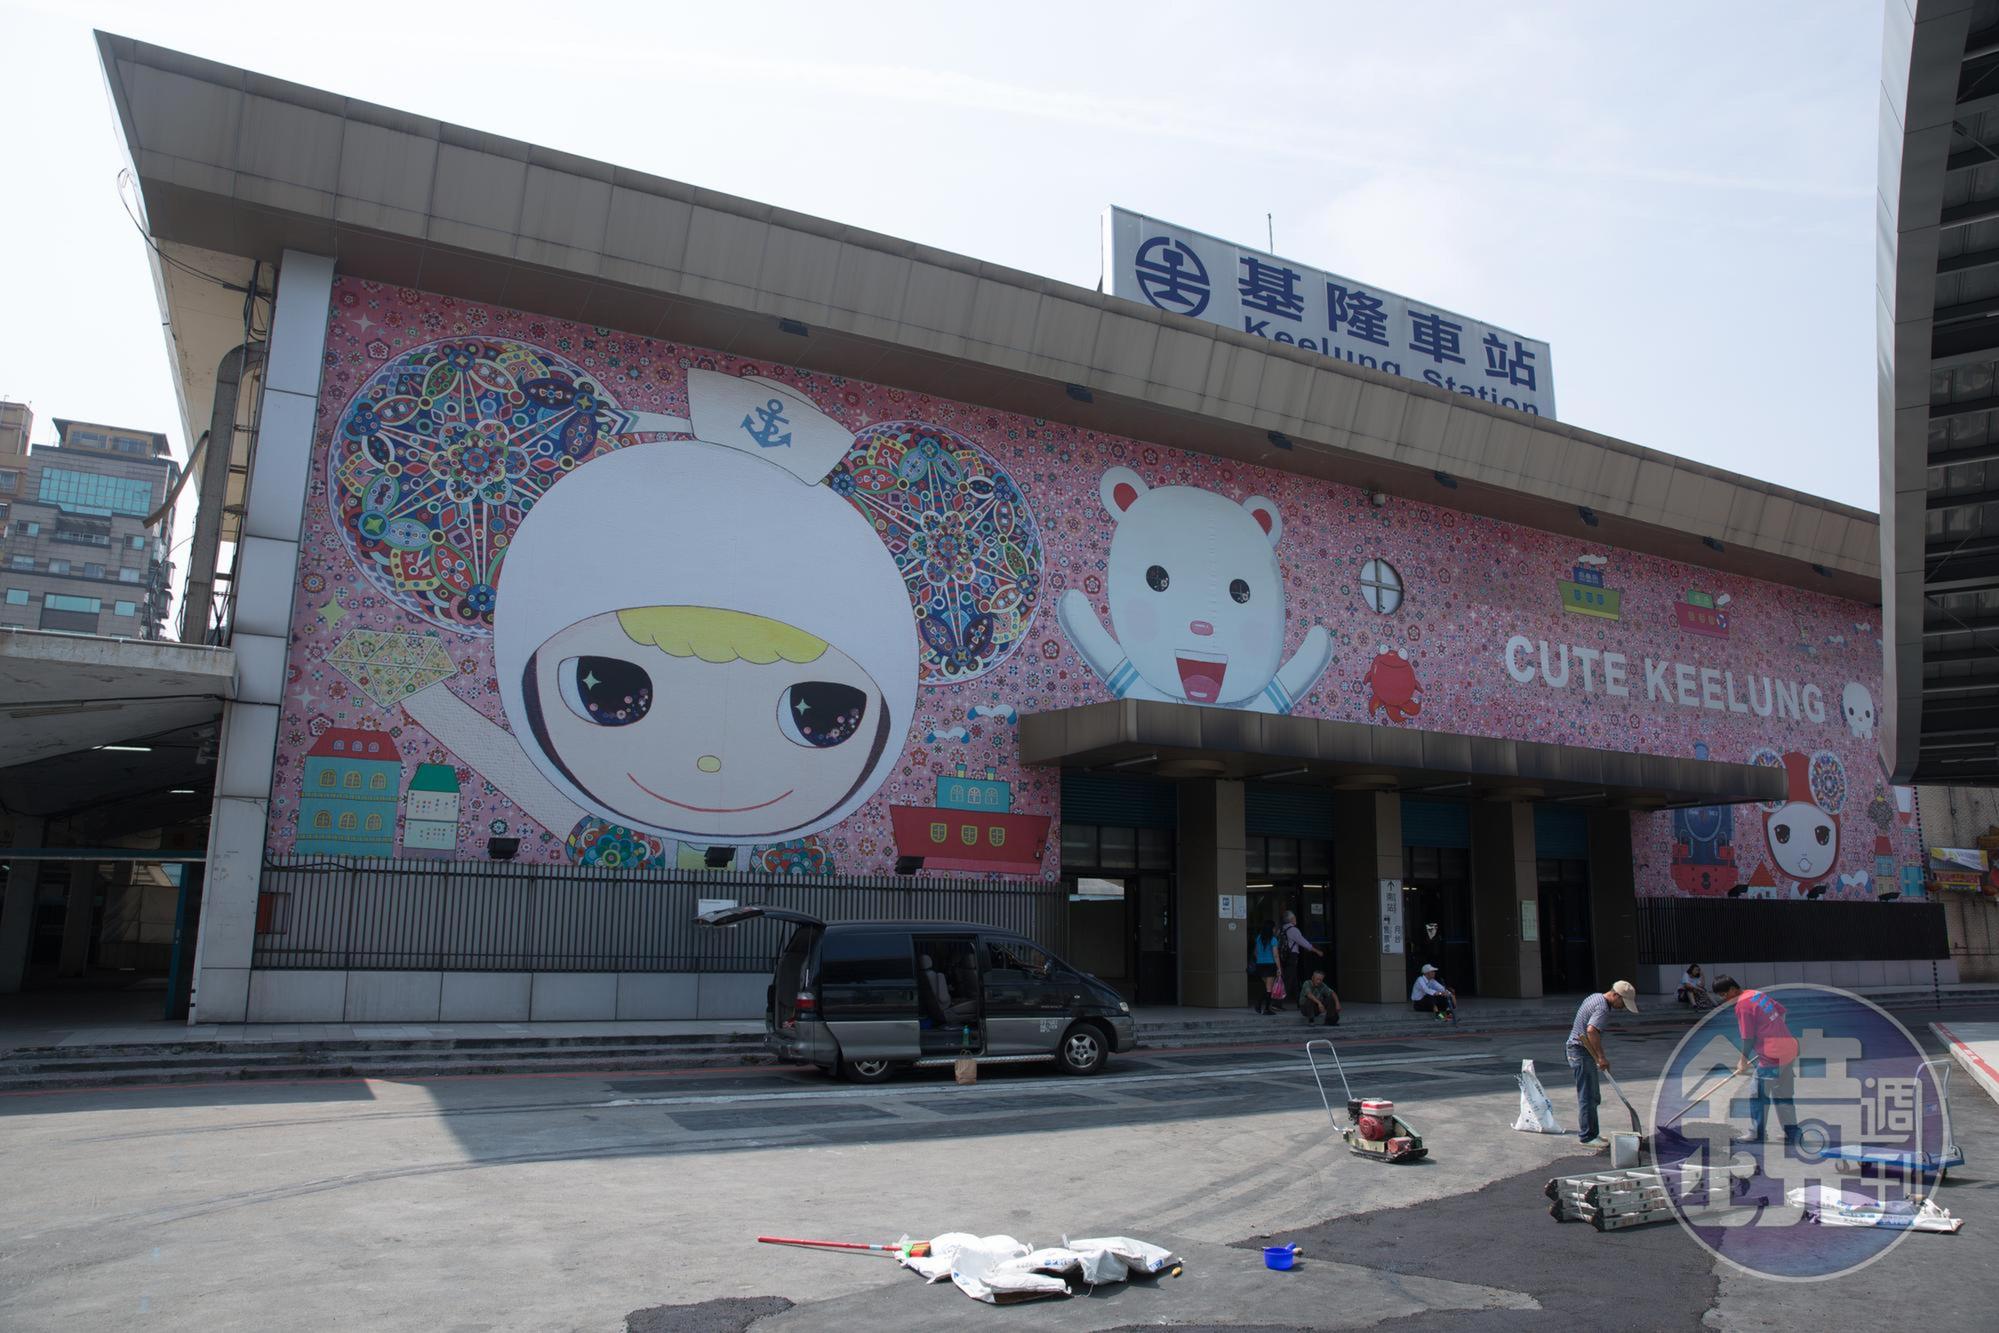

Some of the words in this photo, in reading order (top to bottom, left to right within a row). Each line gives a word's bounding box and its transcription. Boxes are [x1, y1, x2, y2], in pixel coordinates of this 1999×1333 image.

[1238, 256, 1537, 392] 基隆車站
[1505, 635, 1629, 697] CUTE
[1645, 656, 1825, 724] KEELUNG
